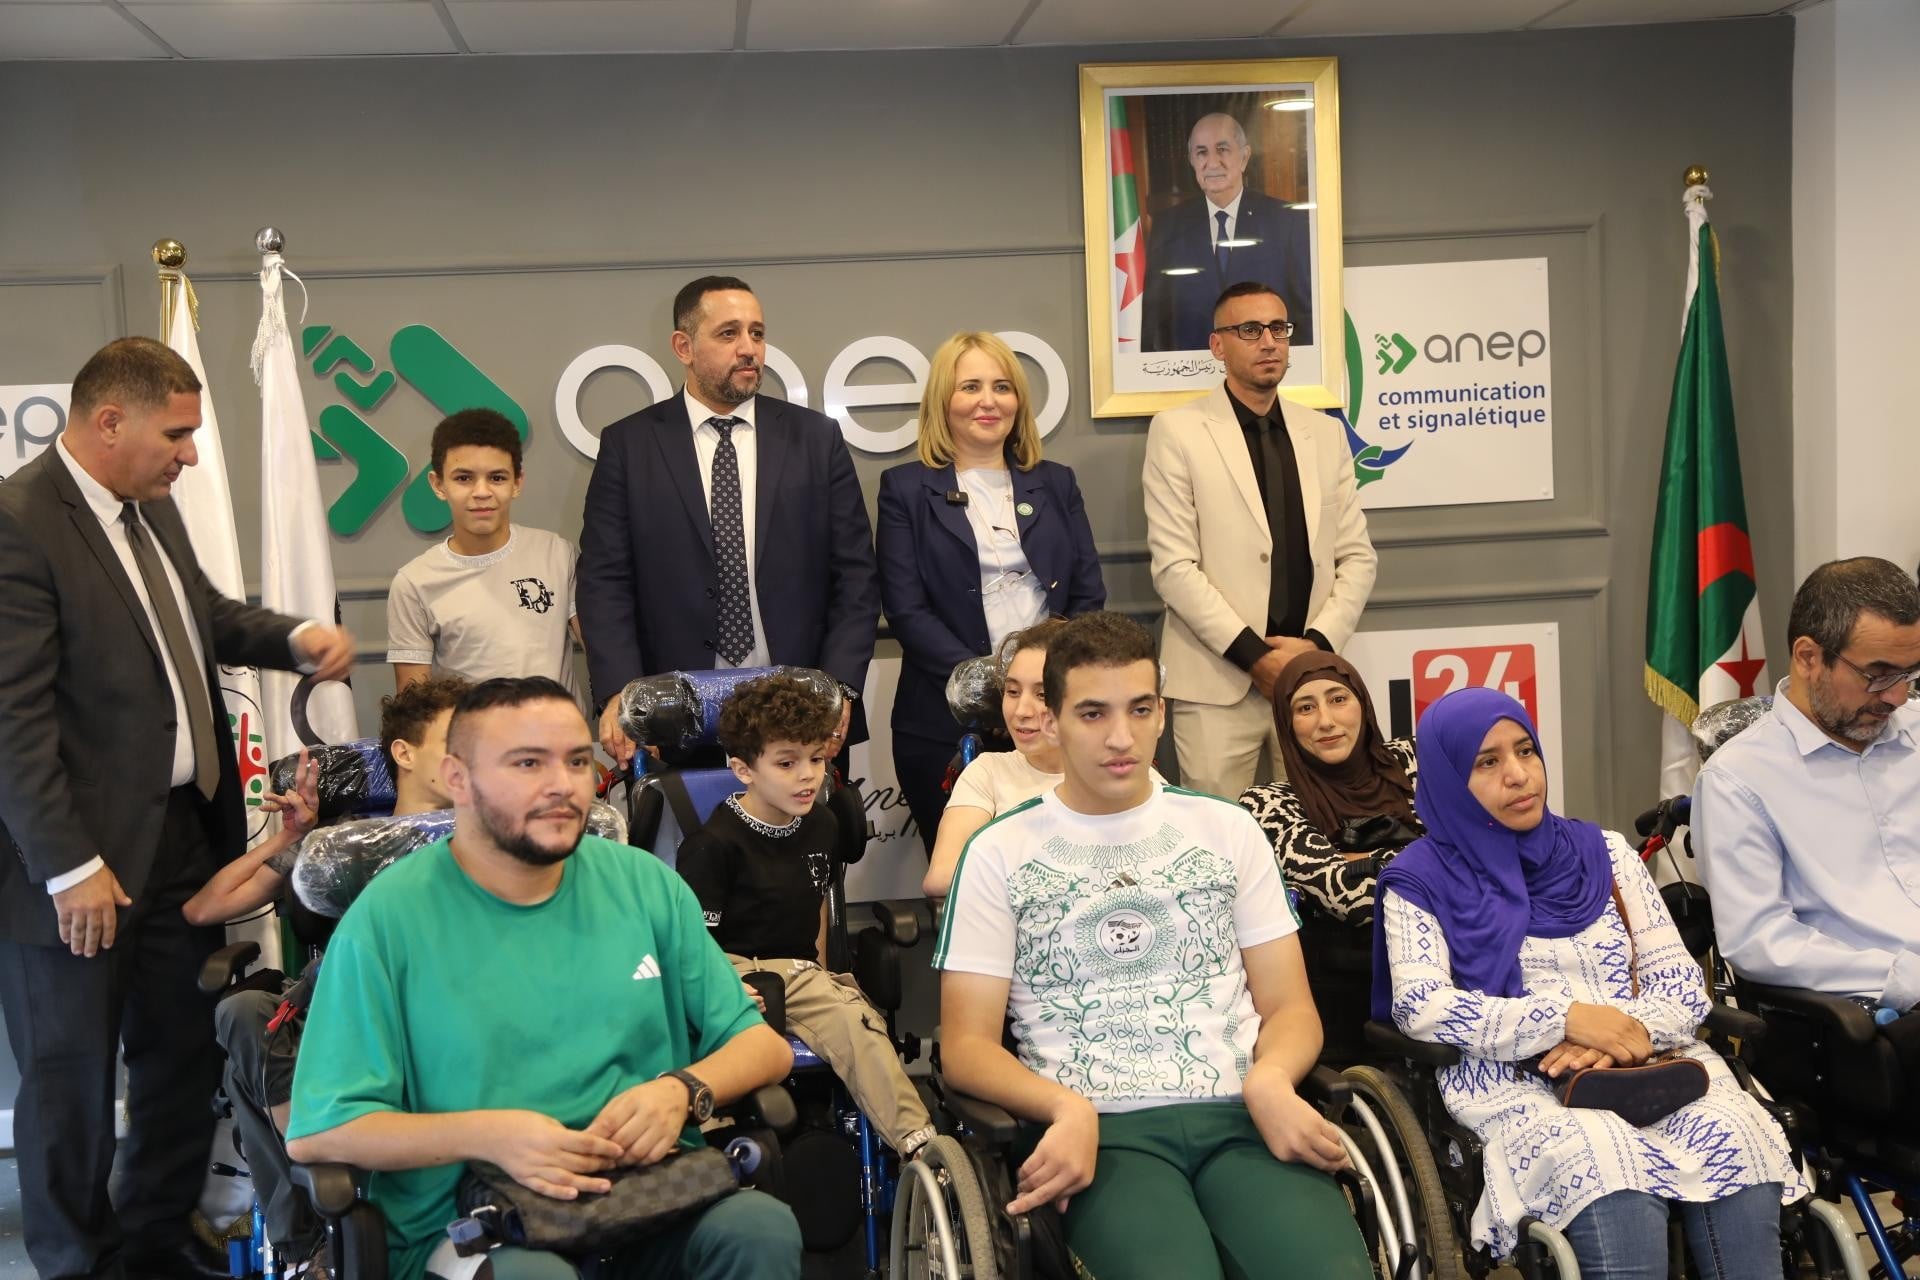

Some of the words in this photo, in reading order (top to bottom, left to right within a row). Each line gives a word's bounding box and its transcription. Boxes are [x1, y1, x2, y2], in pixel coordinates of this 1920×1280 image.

[1423, 329, 1546, 367] anep
[1378, 381, 1546, 406] communication
[1379, 413, 1401, 430] et
[1407, 406, 1546, 433] signalétique
